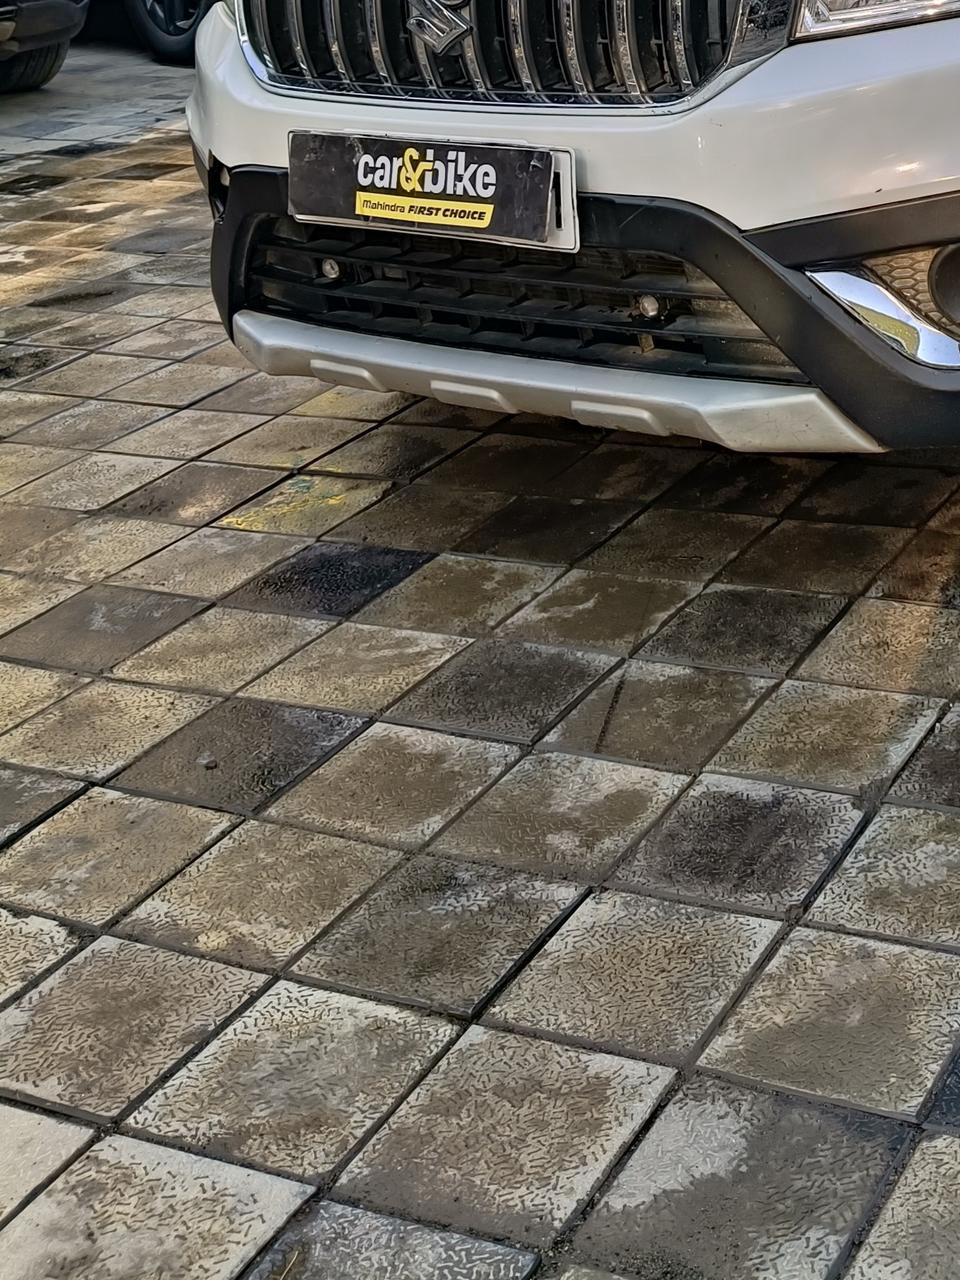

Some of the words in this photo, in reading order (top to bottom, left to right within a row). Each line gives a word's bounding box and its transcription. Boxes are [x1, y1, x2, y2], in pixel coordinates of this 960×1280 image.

[356, 147, 497, 199] car&bike
[362, 199, 406, 213] Mahindra
[407, 204, 441, 217] FIRST
[442, 208, 486, 221] CHOICE
